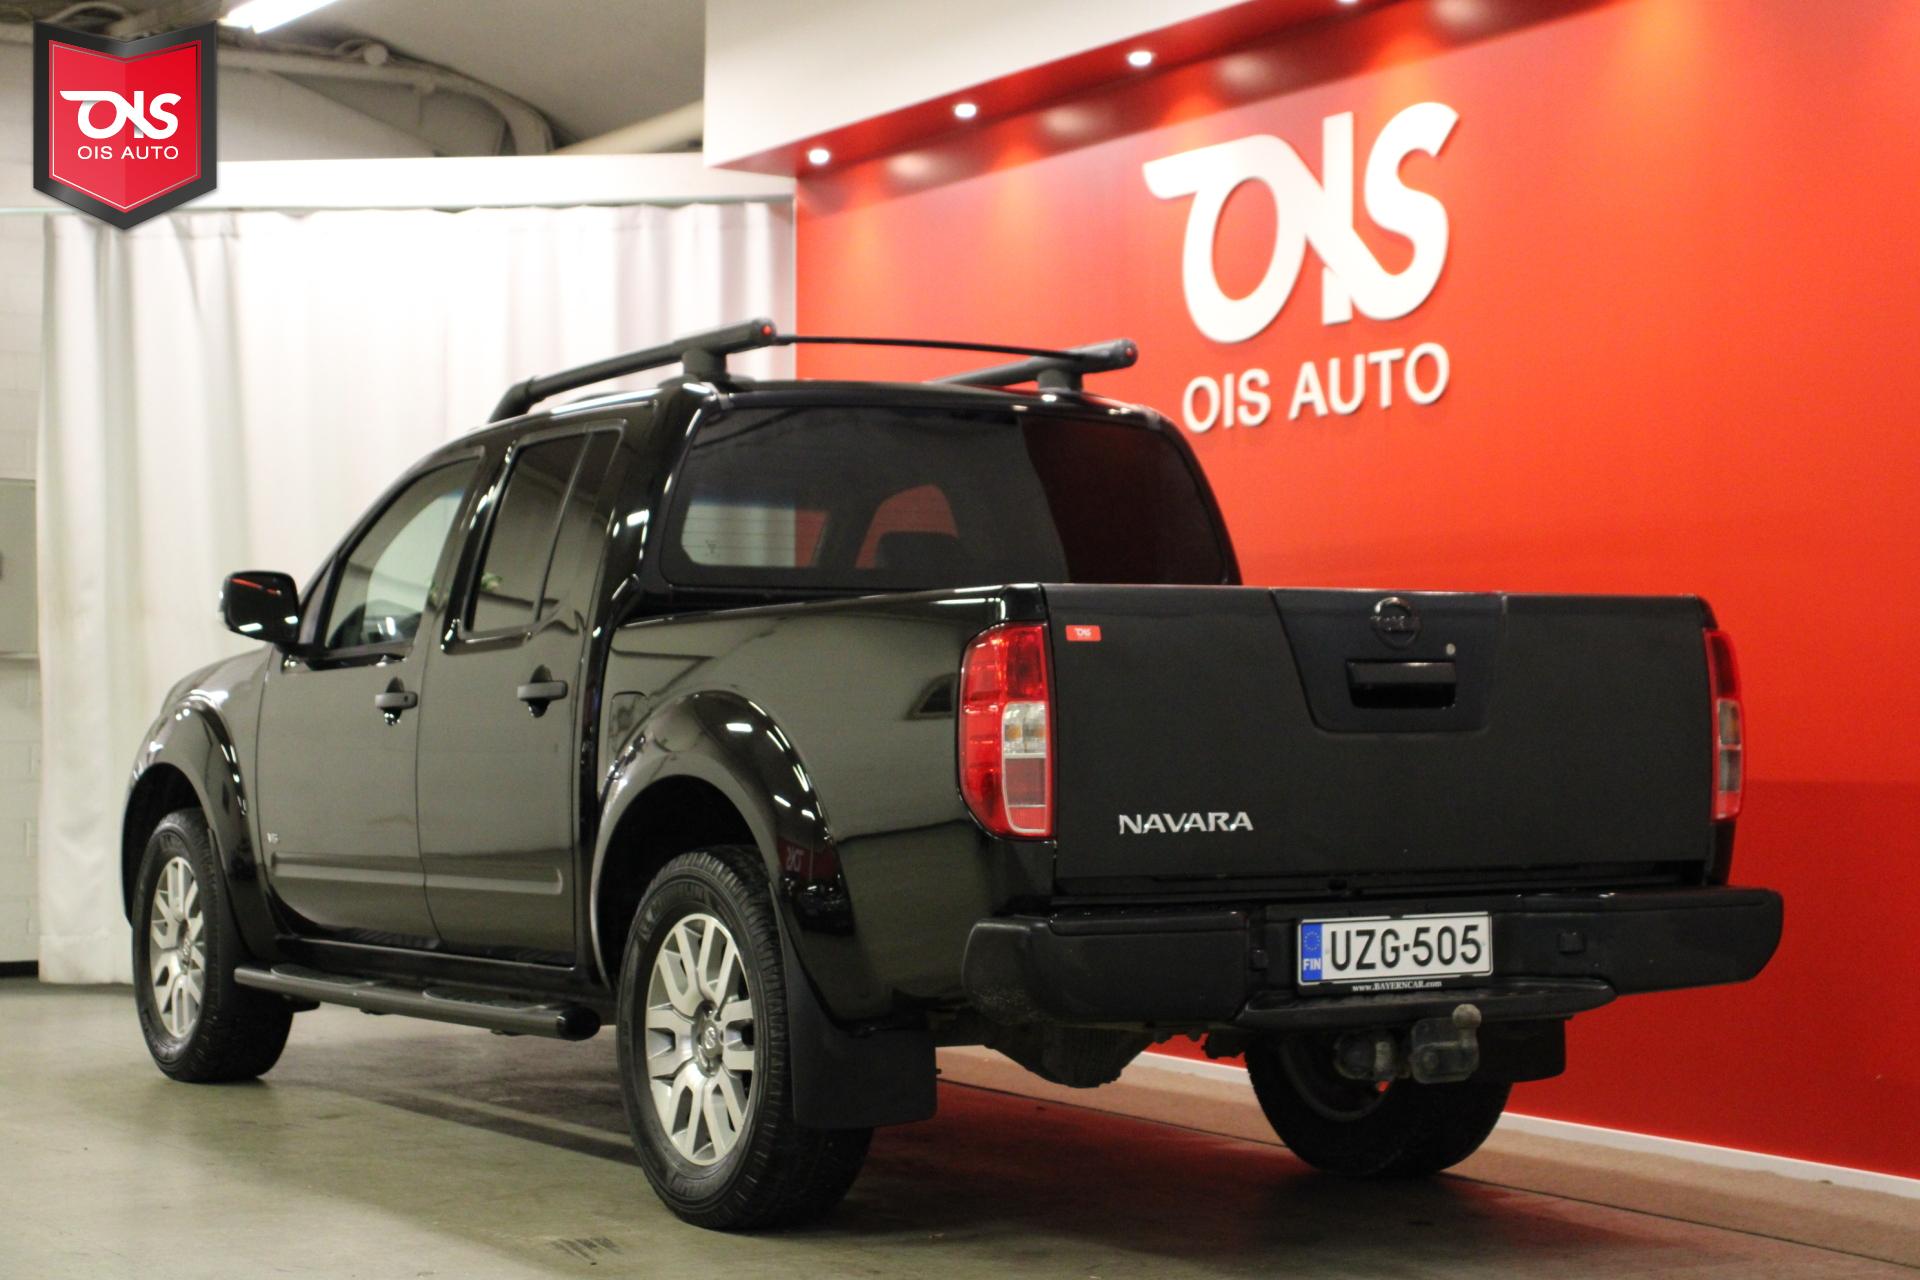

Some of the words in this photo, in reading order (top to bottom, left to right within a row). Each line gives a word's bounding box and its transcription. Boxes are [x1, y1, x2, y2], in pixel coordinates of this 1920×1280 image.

[1142, 101, 1460, 344] OIS
[1182, 368, 1271, 433] OIS
[1288, 342, 1450, 420] AUTO
[1118, 811, 1254, 835] NAVARA
[1303, 958, 1321, 971] FIN
[1331, 924, 1482, 971] UZG-505
